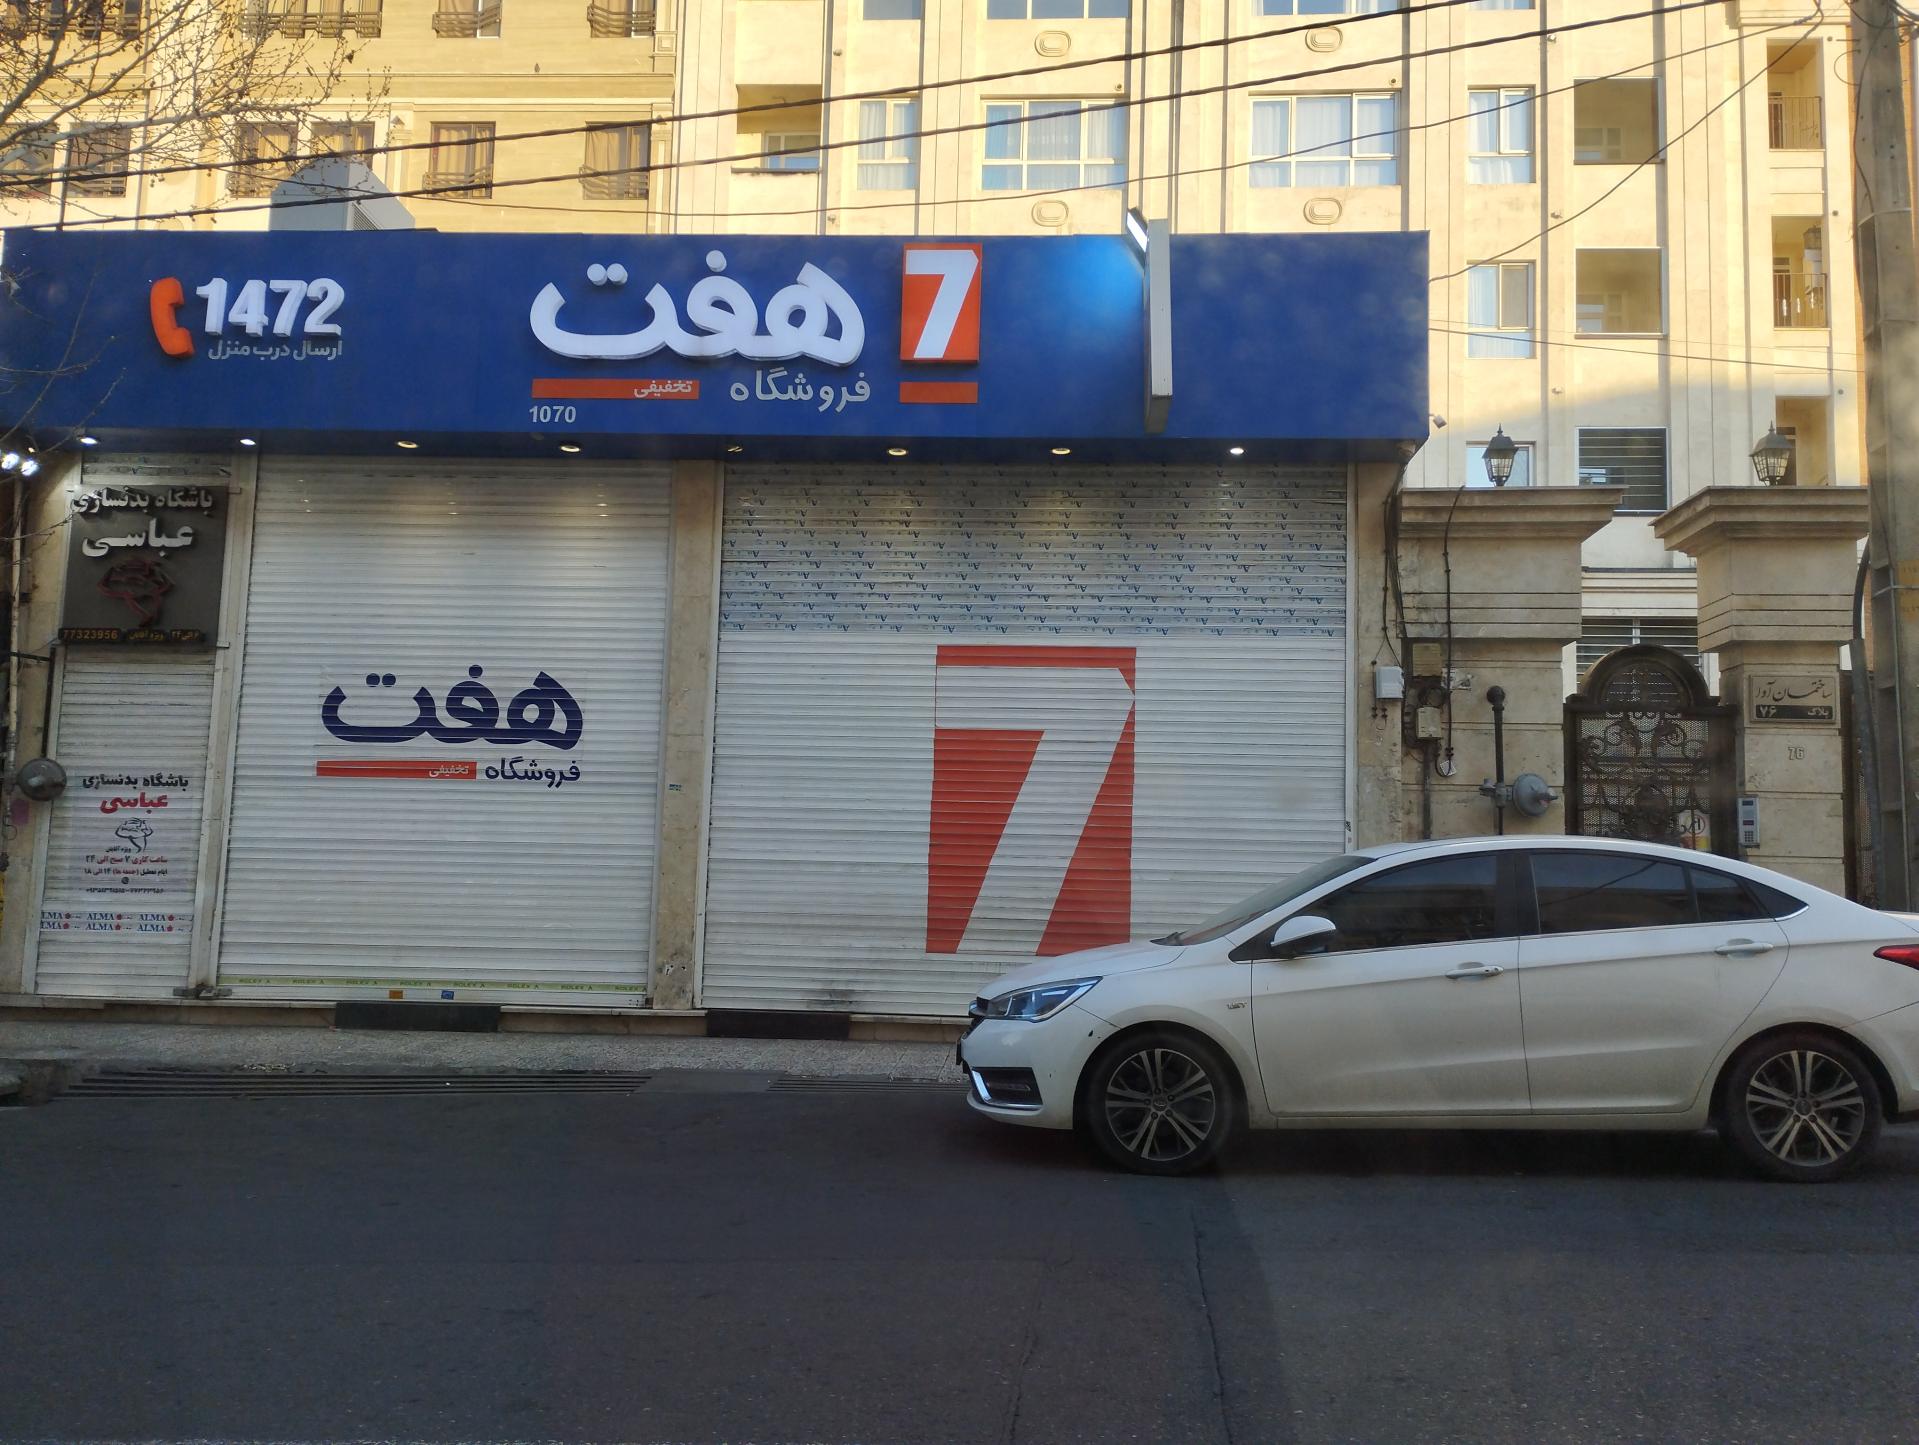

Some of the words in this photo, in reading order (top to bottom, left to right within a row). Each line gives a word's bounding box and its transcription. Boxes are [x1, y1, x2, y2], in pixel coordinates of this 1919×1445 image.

[196, 277, 344, 337] 1472
[530, 249, 866, 367] هفت
[905, 249, 979, 359] 7
[208, 341, 250, 361] منزل
[253, 343, 290, 361] درب
[294, 340, 342, 361] ارسال
[633, 378, 692, 399] تخفیفی
[730, 367, 872, 412] فروشگاه
[529, 405, 577, 424] 1070
[71, 486, 150, 513] بدنسازی
[82, 518, 194, 557] عباسی
[1772, 680, 1833, 702] ساختمان
[322, 664, 583, 750] هفت
[1760, 706, 1777, 718] ۷۶
[1807, 707, 1829, 719] پلاک
[1788, 746, 1805, 761] 76
[429, 764, 470, 778] تخفیفی
[485, 756, 581, 788] فروشگاه
[82, 774, 138, 790] بدنسازی
[142, 773, 189, 791] باشگاه
[100, 792, 168, 814] عباسی
[936, 666, 1135, 953] 7
[39, 921, 62, 930] LMA
[85, 922, 114, 931] ALMA
[136, 923, 165, 932] ALMA
[40, 912, 63, 920] LMA
[86, 912, 115, 921] ALMA
[138, 913, 166, 922] ALMA
